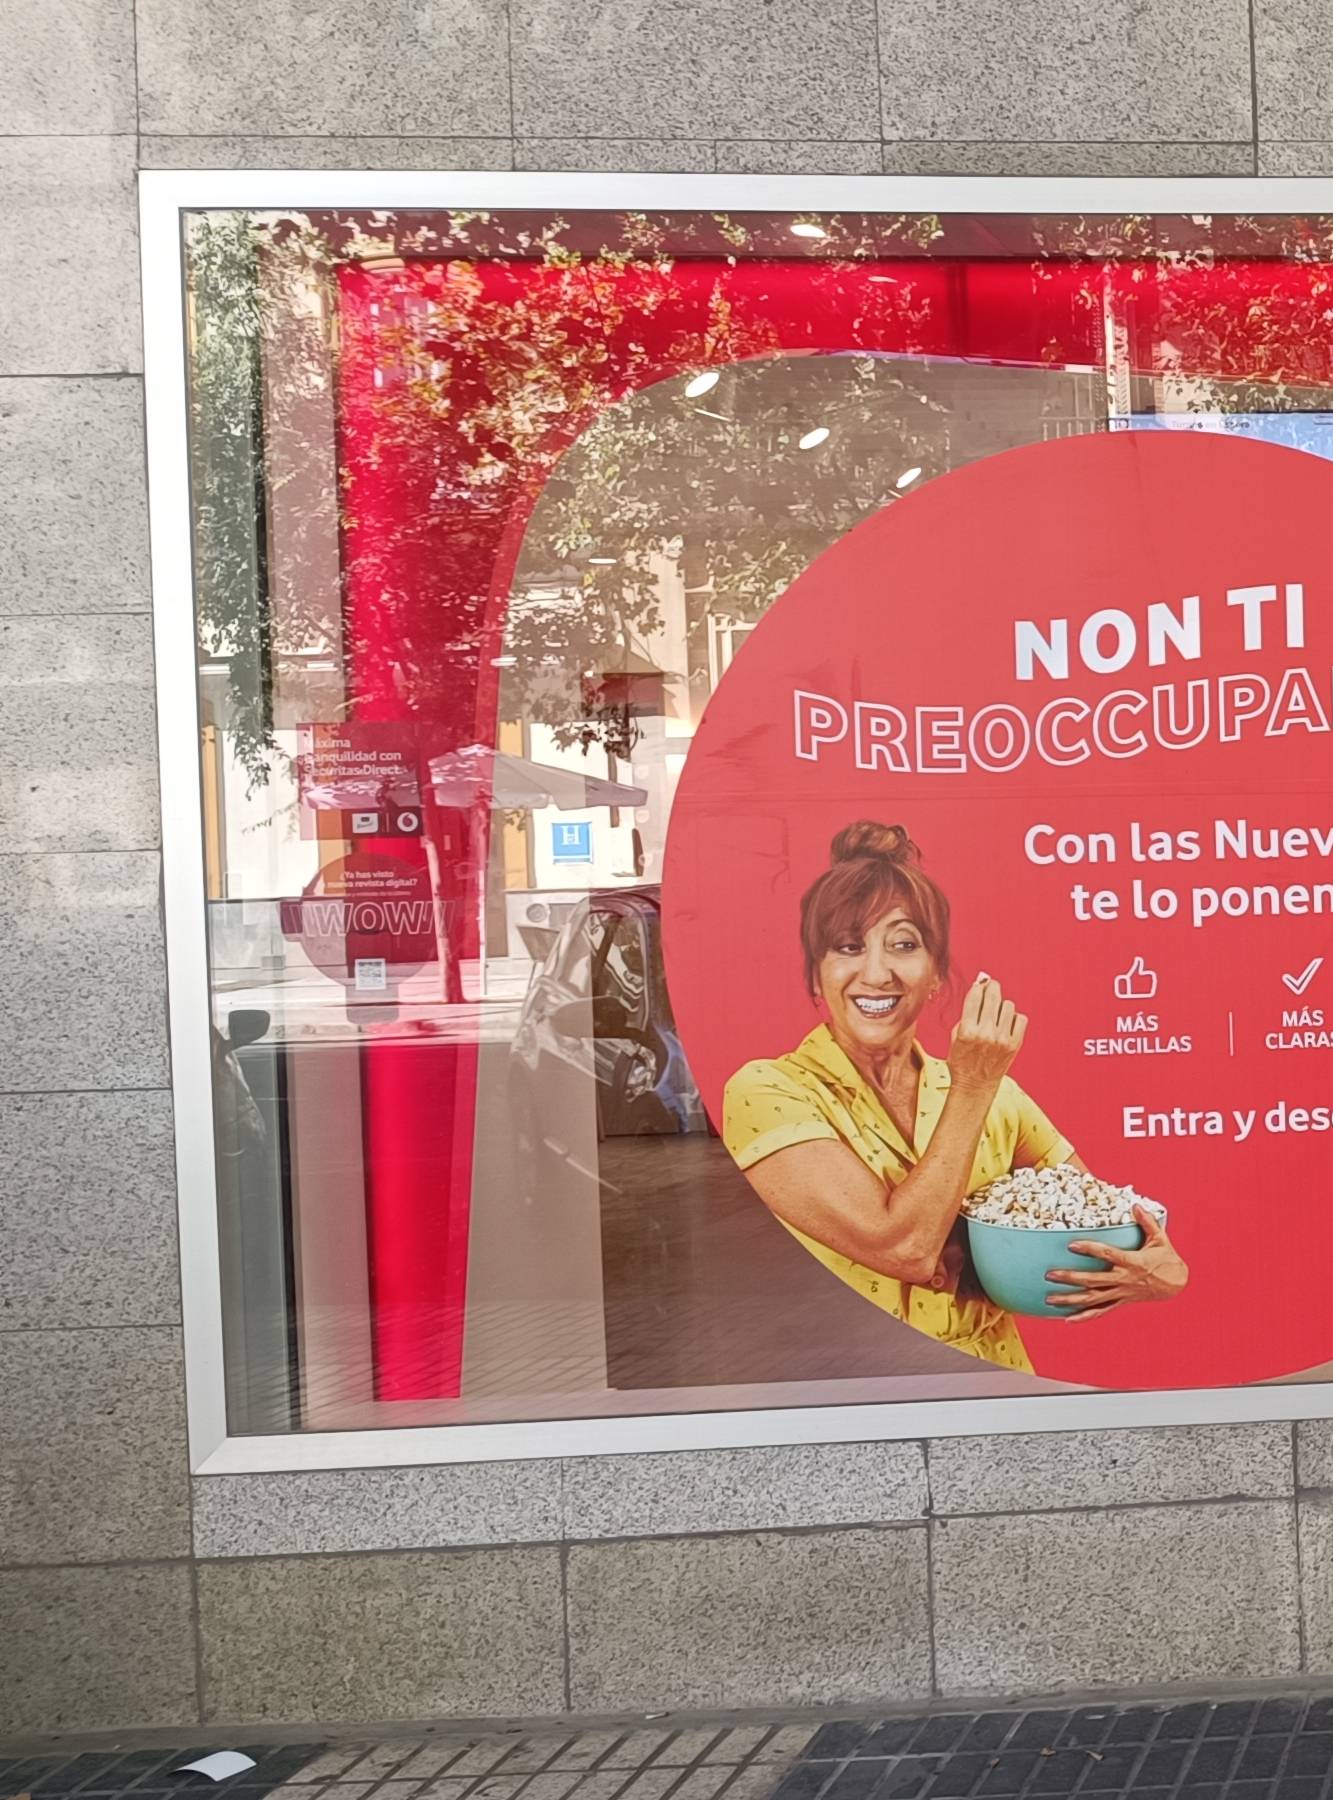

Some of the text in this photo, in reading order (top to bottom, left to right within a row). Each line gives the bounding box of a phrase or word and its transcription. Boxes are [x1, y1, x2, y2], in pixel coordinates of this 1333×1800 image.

[1014, 583, 1306, 682] NON TI
[379, 752, 402, 761] con
[1024, 824, 1116, 865] Con
[1130, 822, 1201, 862] las
[1070, 884, 1119, 921] te
[1132, 879, 1178, 919] lo
[1116, 1011, 1159, 1033] MÁS
[1282, 1005, 1324, 1027] MÁS
[1083, 1035, 1193, 1056] SENCILLAS
[1123, 1106, 1224, 1138] Entra
[1232, 1110, 1256, 1142] y
